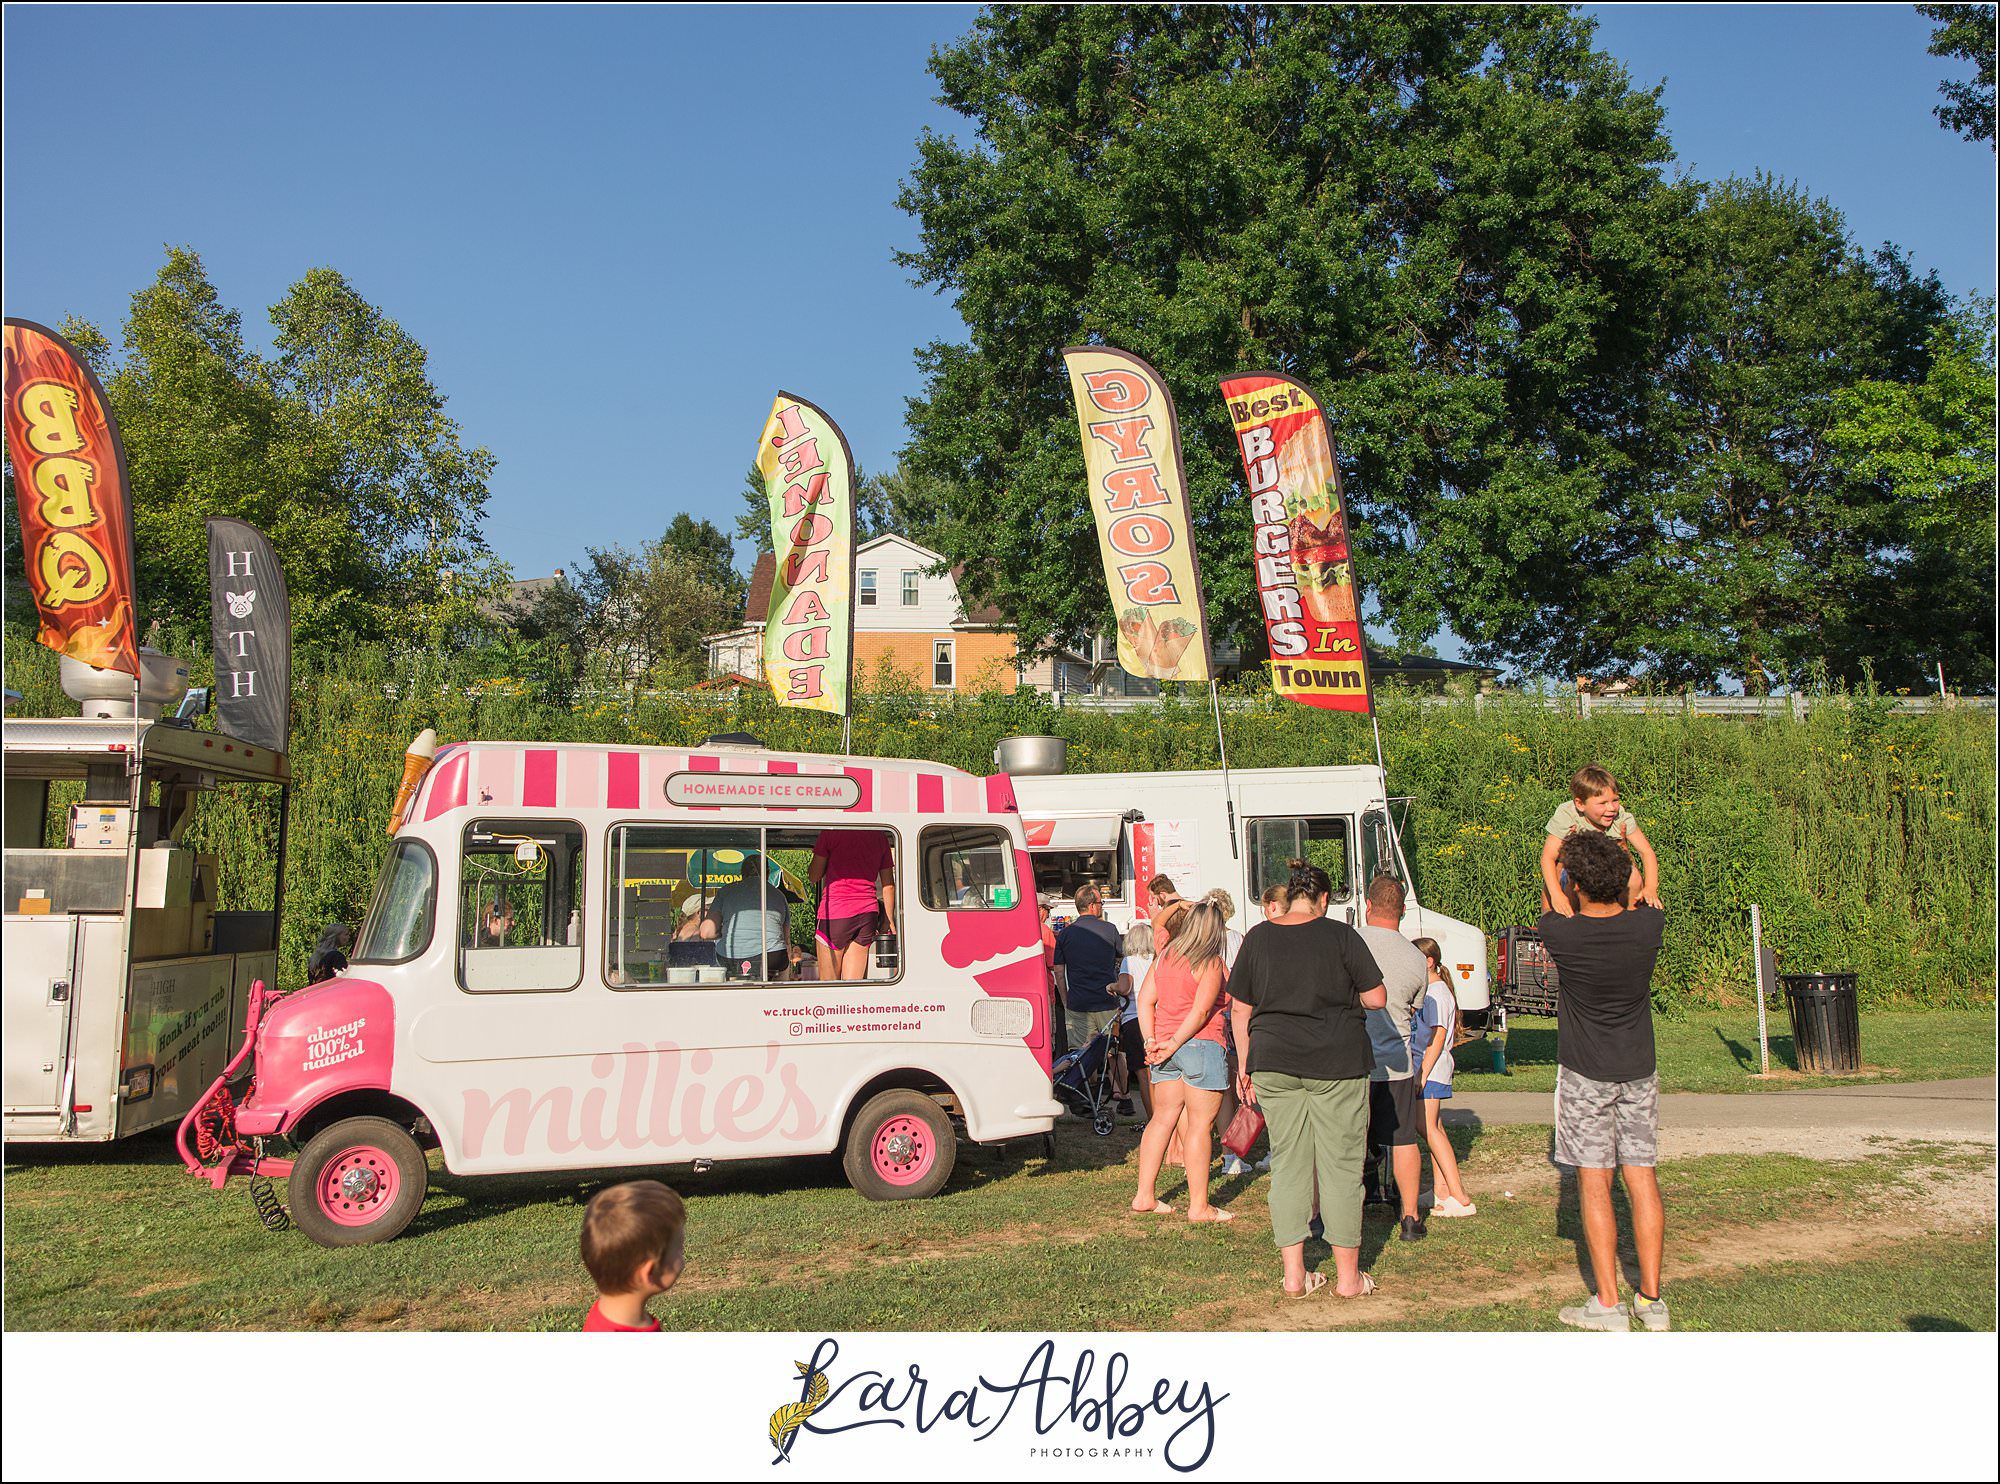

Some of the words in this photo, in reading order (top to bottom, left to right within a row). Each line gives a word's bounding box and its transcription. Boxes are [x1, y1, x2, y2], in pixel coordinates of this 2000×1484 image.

[1229, 388, 1304, 425] Best
[1240, 425, 1309, 656] BURGERS
[1313, 626, 1357, 653] In
[1275, 664, 1362, 689] Town
[683, 783, 765, 796] HOMEMADE
[770, 785, 791, 796] ICE
[796, 786, 843, 798] CREAM
[1141, 845, 1149, 882] MENU
[152, 978, 176, 996] HIGH
[158, 1022, 183, 1053] Honk
[184, 1009, 194, 1031] if
[193, 1001, 209, 1027] you
[210, 985, 226, 1009] rub
[763, 1003, 946, 1019] wc.truck@millieshomemade.com
[307, 1018, 366, 1043] always
[805, 1020, 922, 1034] millies_westmoreland
[155, 1058, 177, 1087] your
[178, 1035, 201, 1062] meat
[303, 1039, 365, 1071] natural
[307, 1035, 350, 1060] 100%
[461, 1040, 828, 1161] millie's
